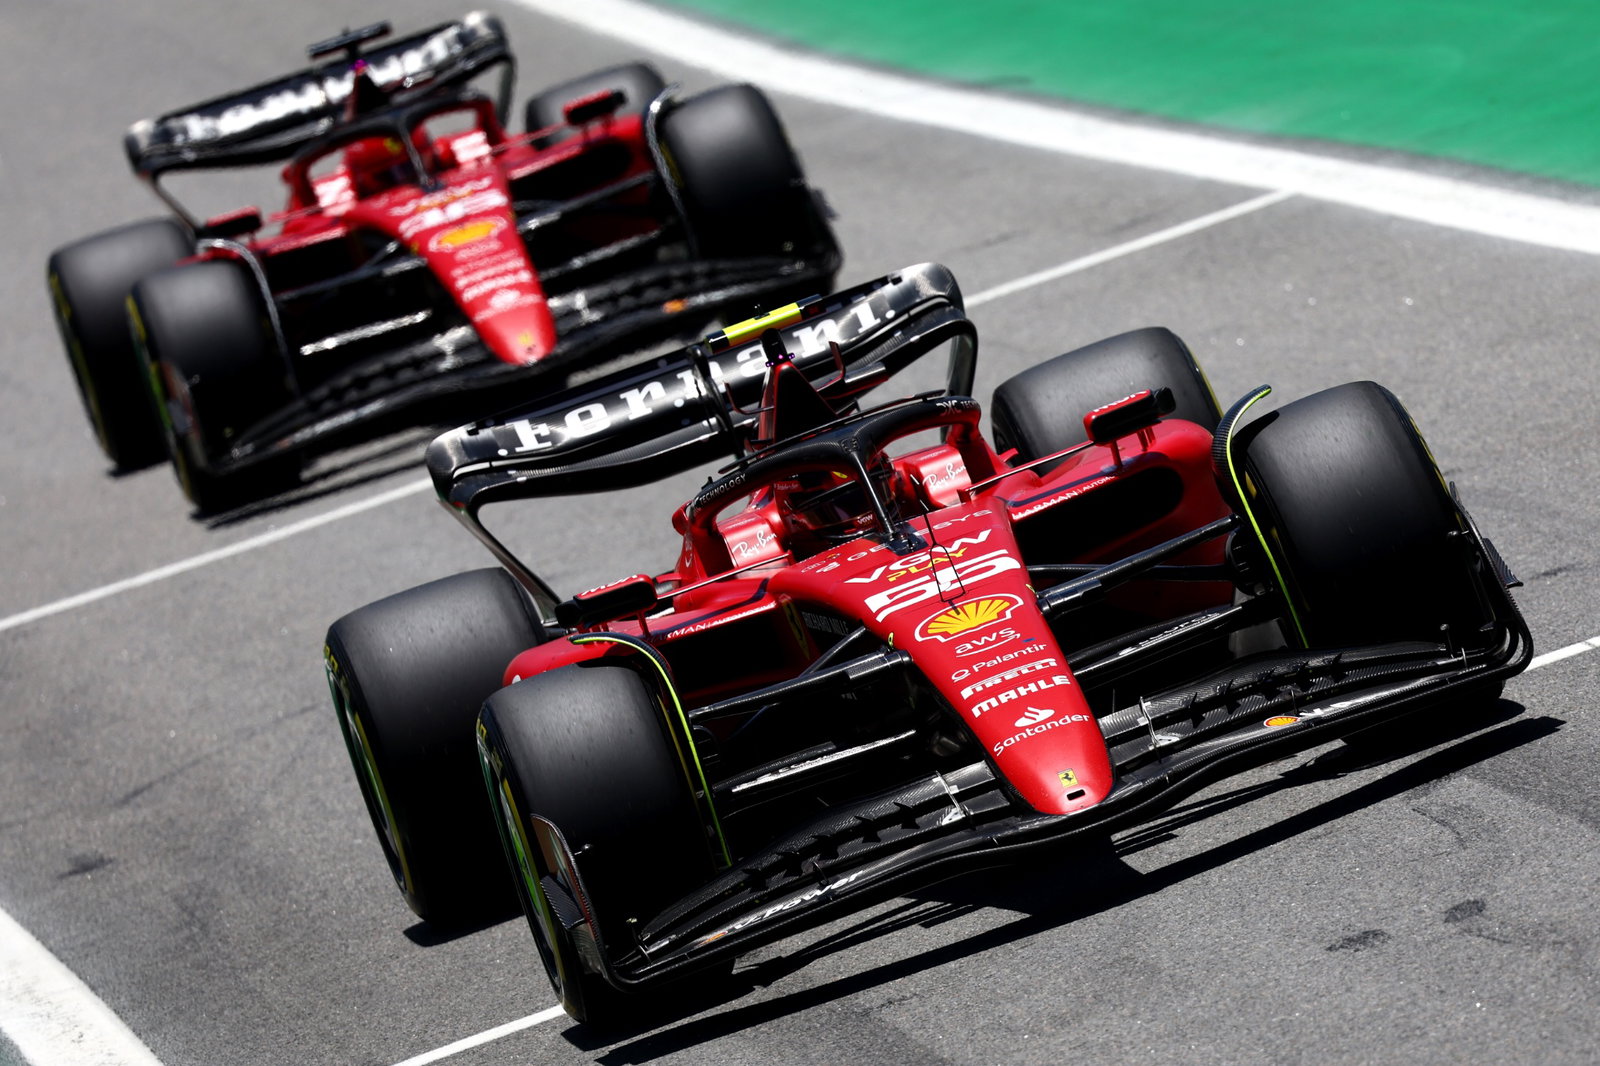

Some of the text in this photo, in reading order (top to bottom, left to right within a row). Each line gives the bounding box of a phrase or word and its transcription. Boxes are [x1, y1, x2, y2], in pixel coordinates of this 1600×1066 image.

[699, 474, 746, 506] TECHNOLOGY
[732, 530, 777, 558] Ray-Ban
[844, 529, 992, 584] VGW
[886, 547, 967, 582] PLAY
[864, 549, 1021, 623] 55
[955, 626, 1016, 655] aws
[973, 642, 1047, 673] Palantir
[960, 658, 1058, 700] PIRELLI
[971, 674, 1071, 718] MAHLE
